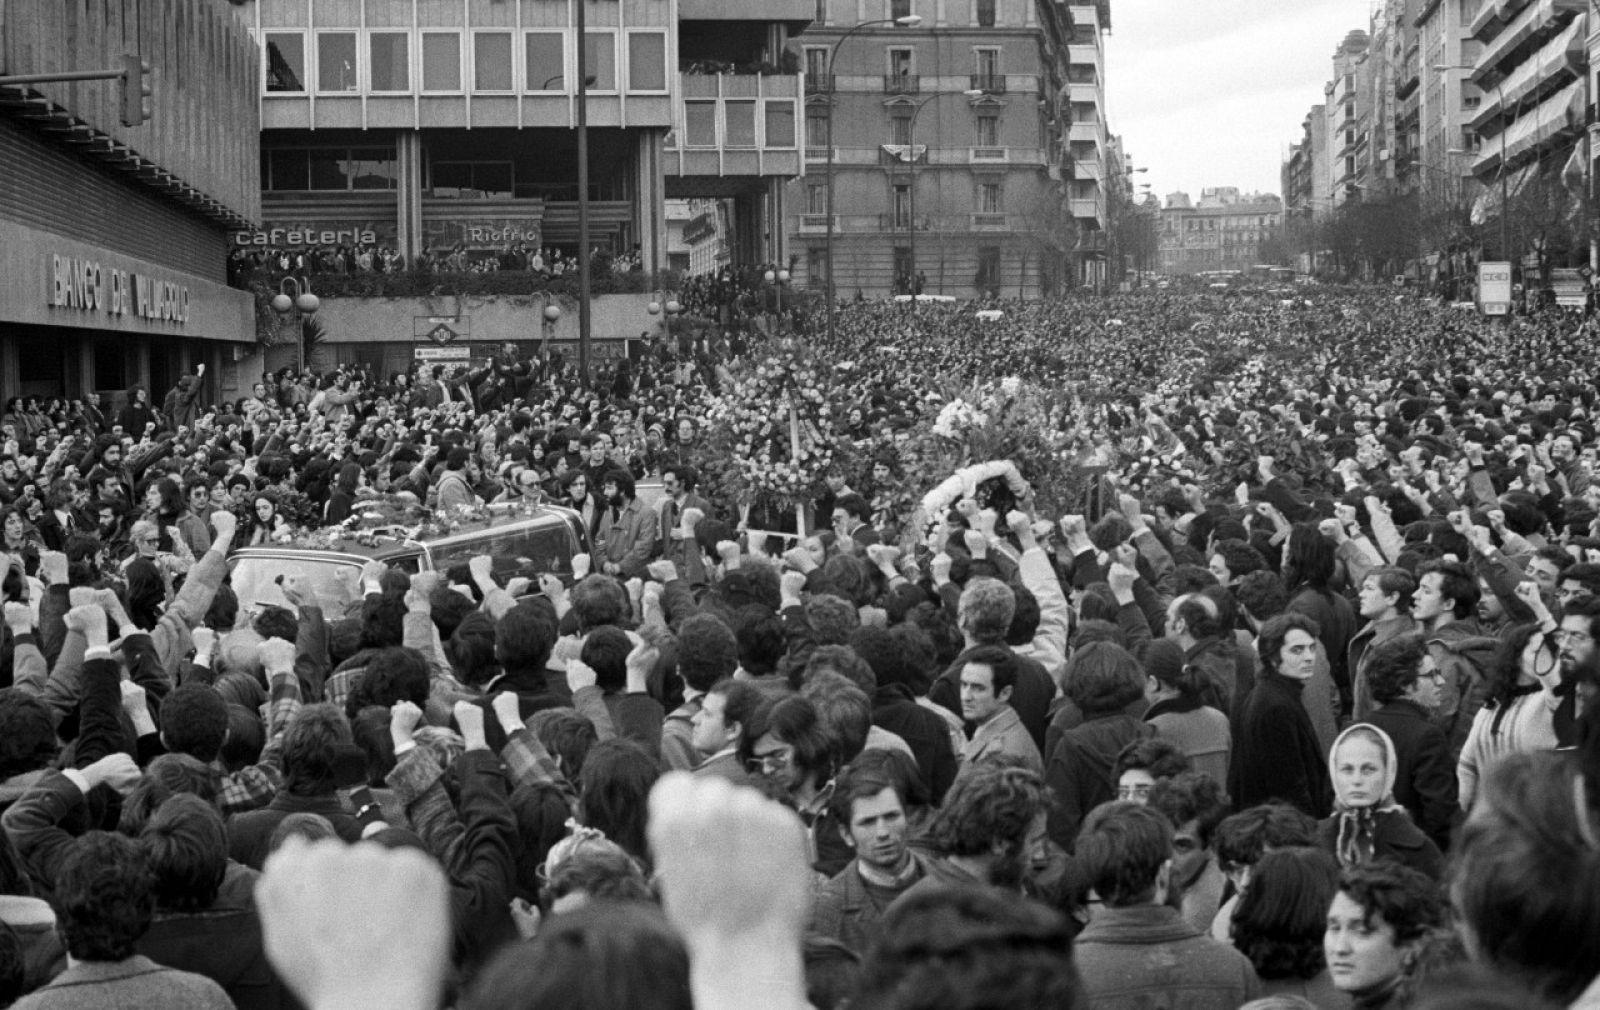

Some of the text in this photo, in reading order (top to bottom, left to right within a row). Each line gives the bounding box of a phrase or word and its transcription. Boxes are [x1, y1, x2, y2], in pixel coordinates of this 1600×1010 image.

[235, 227, 376, 245] cafeteria
[53, 253, 102, 310] BANCO
[112, 268, 127, 315] DE
